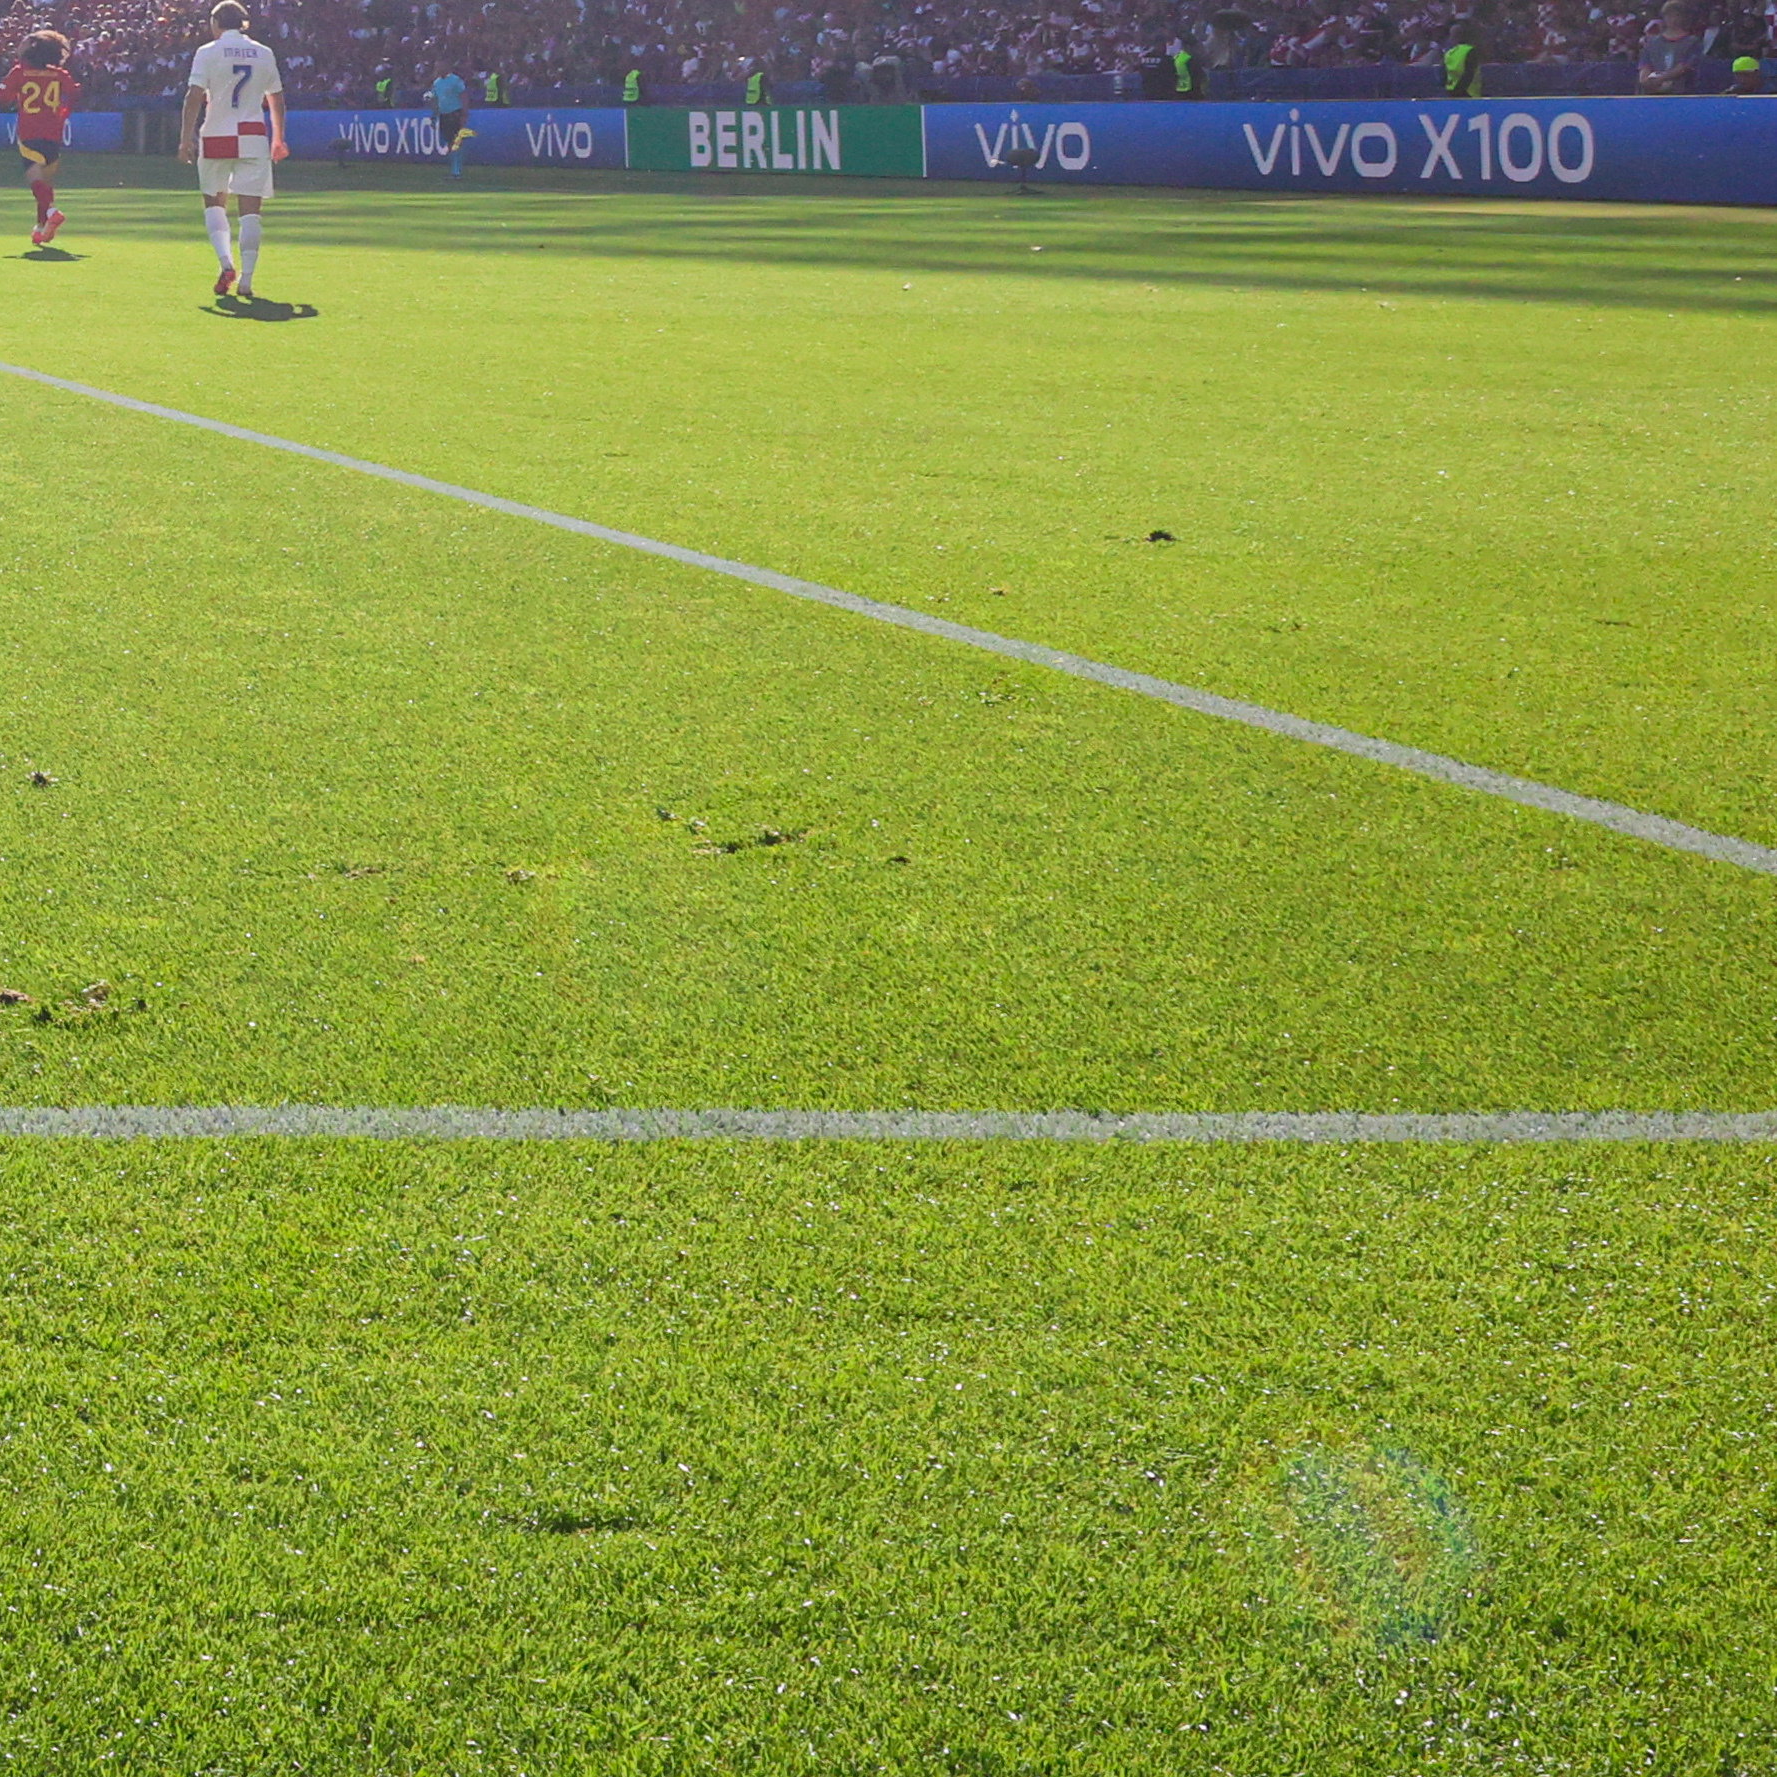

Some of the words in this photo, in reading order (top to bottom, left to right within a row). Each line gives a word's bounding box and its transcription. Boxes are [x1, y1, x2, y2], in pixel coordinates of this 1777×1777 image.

[22, 81, 61, 114] 24
[231, 65, 252, 109] 7
[339, 114, 389, 154] vivo
[525, 113, 592, 159] vivo
[688, 109, 841, 170] BERLIN
[975, 109, 1091, 171] vivo
[1243, 108, 1397, 177] vivo
[1418, 112, 1594, 183] X100
